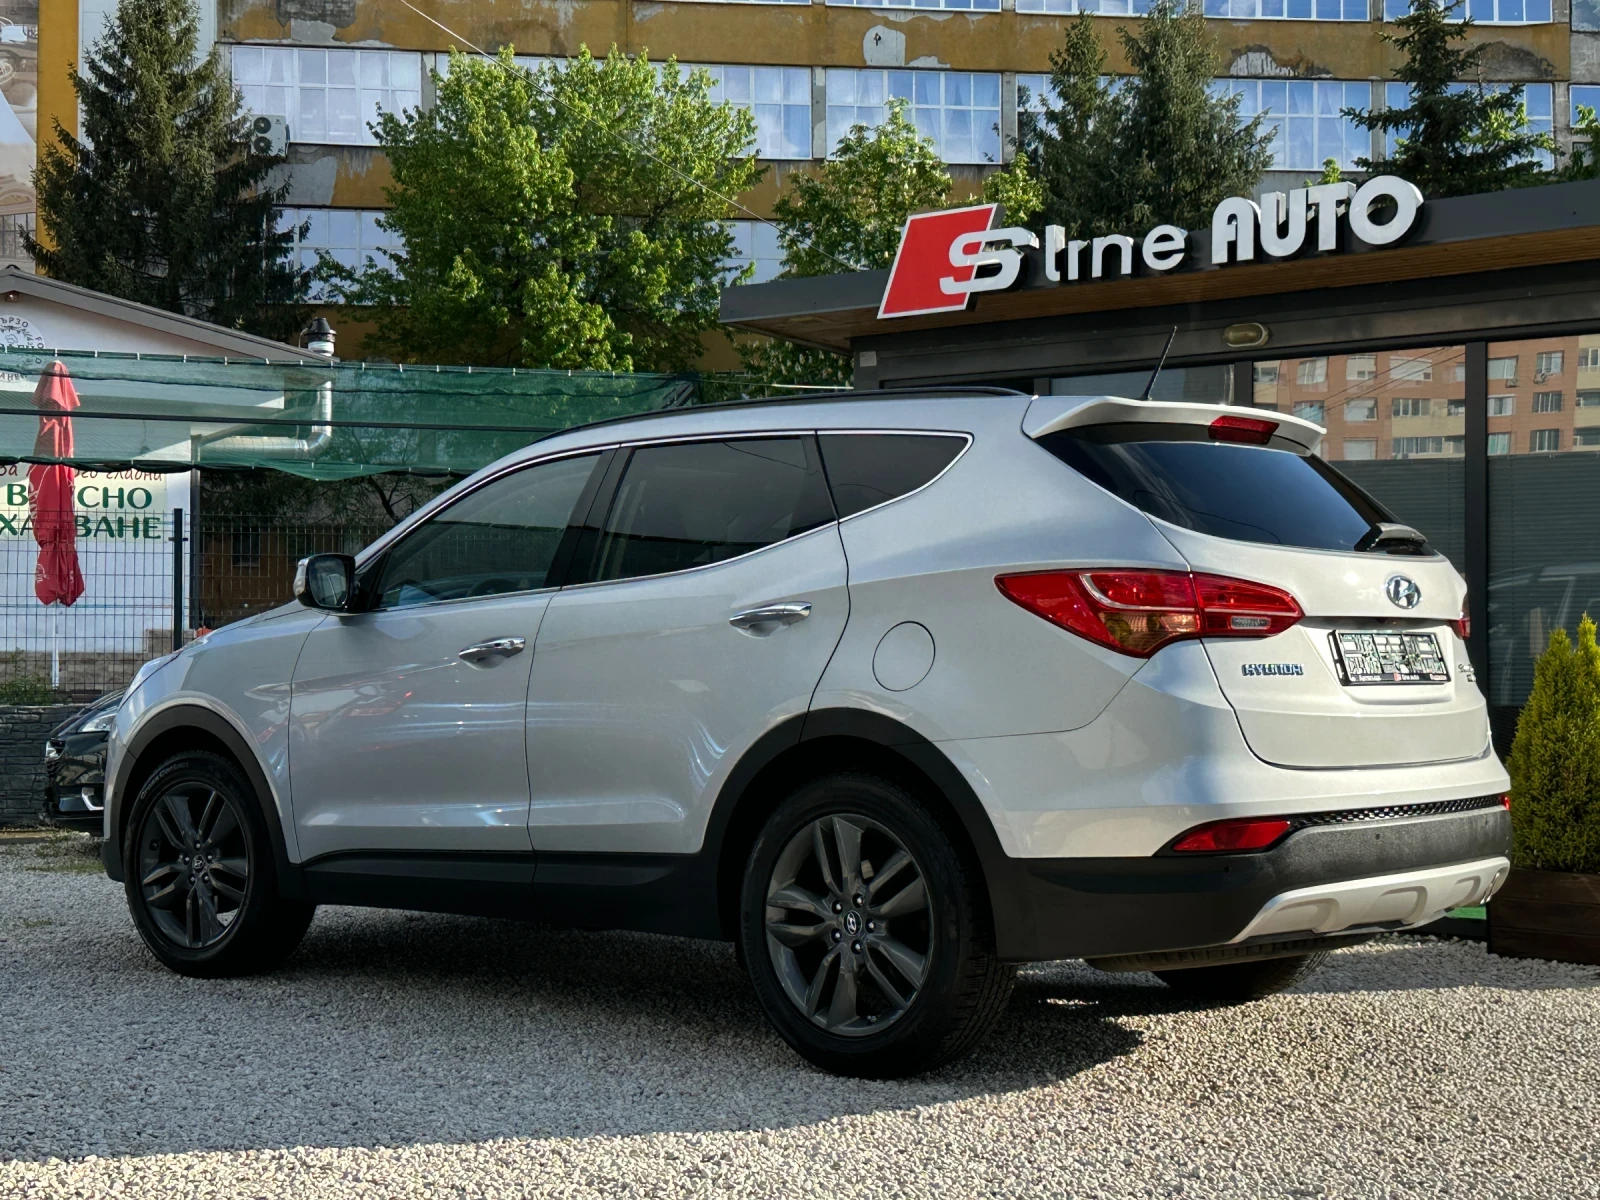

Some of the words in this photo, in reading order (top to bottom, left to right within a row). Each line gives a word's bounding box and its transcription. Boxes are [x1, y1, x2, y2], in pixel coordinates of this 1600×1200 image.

[939, 226, 1039, 295] S
[1212, 175, 1424, 265] AUTO
[0, 317, 29, 328] ЪРЗО
[7, 483, 153, 510] ВСНО
